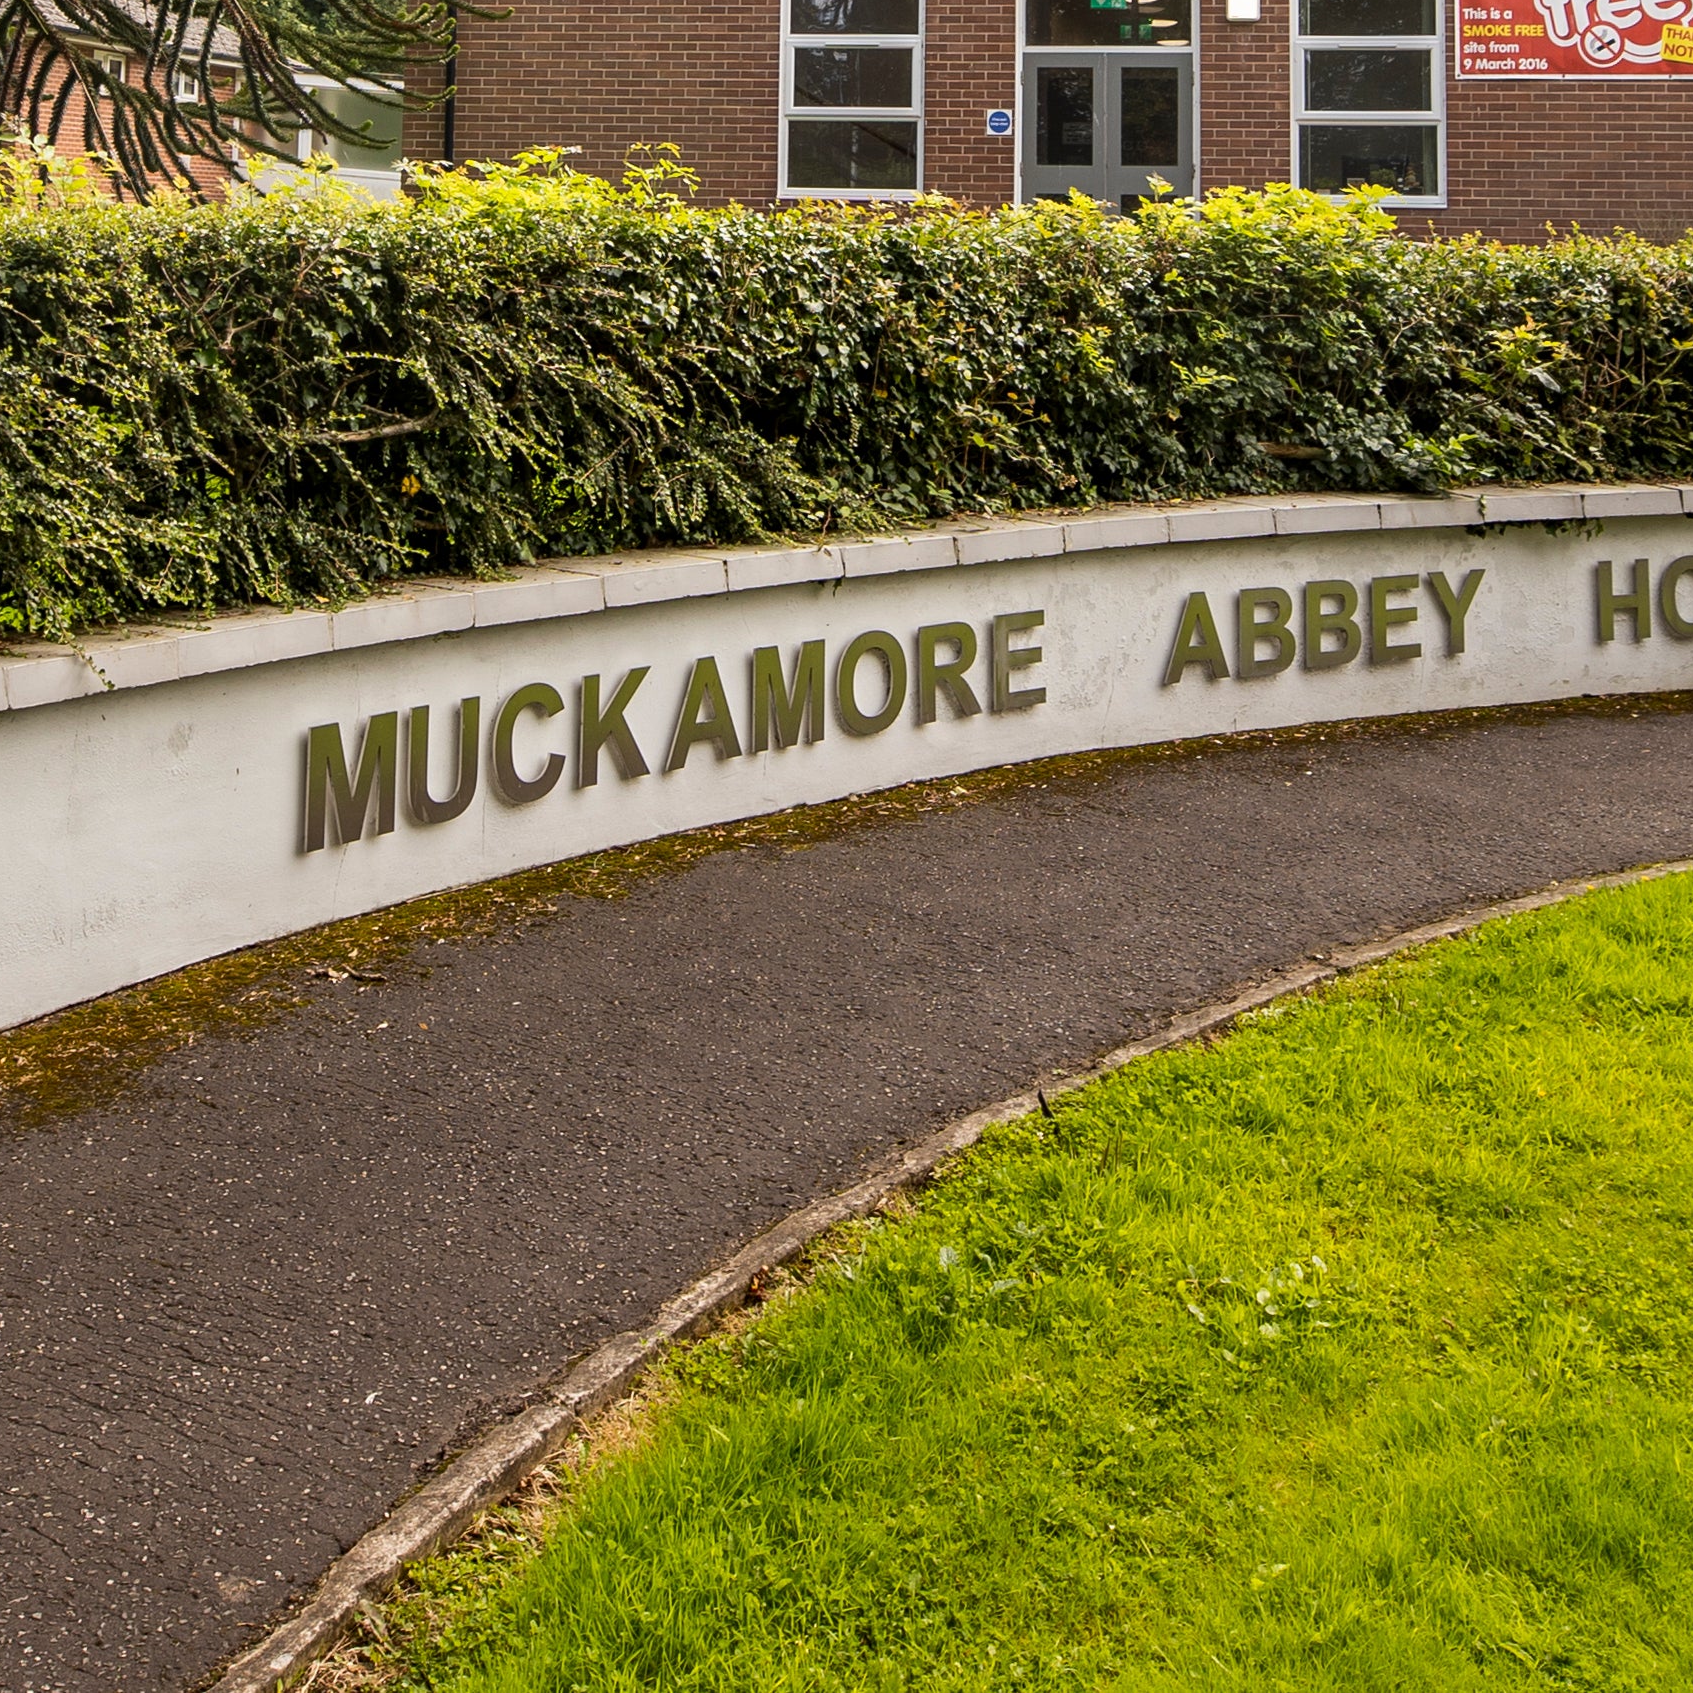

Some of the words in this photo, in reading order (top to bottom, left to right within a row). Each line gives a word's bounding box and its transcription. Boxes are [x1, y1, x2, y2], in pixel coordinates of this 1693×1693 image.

[1462, 7, 1485, 20] This
[1490, 7, 1501, 20] is
[1503, 10, 1513, 20] a
[1462, 24, 1512, 37] SMOKE
[1514, 24, 1545, 37] FREE
[1463, 41, 1486, 54] site
[1489, 41, 1520, 54] from
[1463, 58, 1473, 70] 9
[1475, 57, 1516, 70] March
[1518, 58, 1549, 70] 2016
[304, 609, 1047, 854] MUCKAMORE
[1162, 567, 1487, 686] ABBEY
